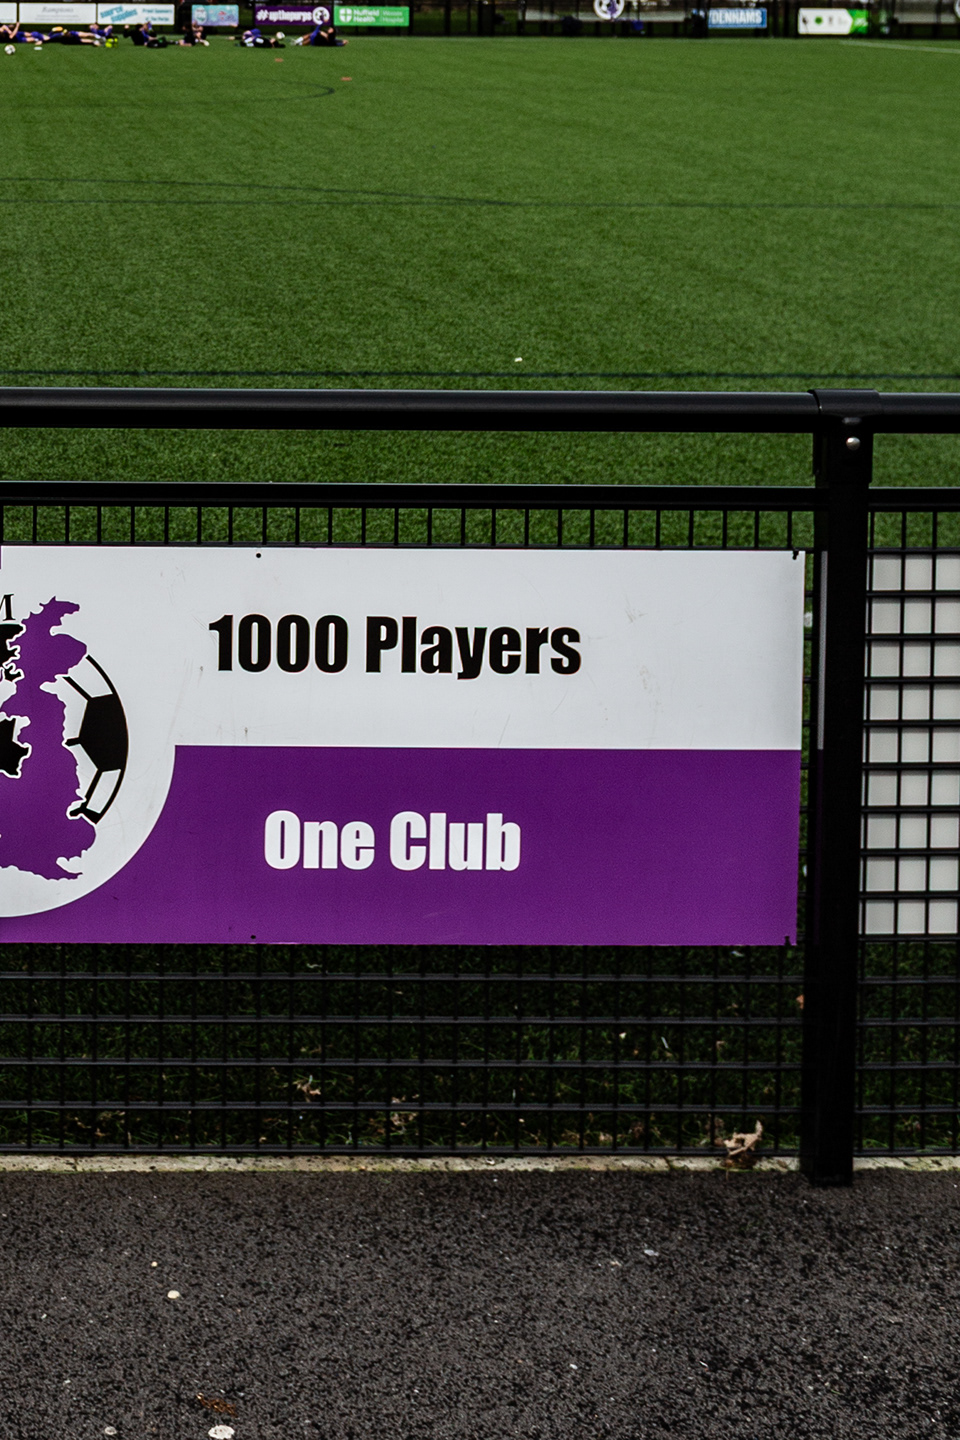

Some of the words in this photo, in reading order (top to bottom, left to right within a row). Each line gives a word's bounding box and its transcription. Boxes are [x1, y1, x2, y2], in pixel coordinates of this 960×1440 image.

[209, 614, 348, 673] 1000
[366, 617, 581, 679] Players
[265, 811, 374, 869] One
[390, 812, 520, 871] Club
